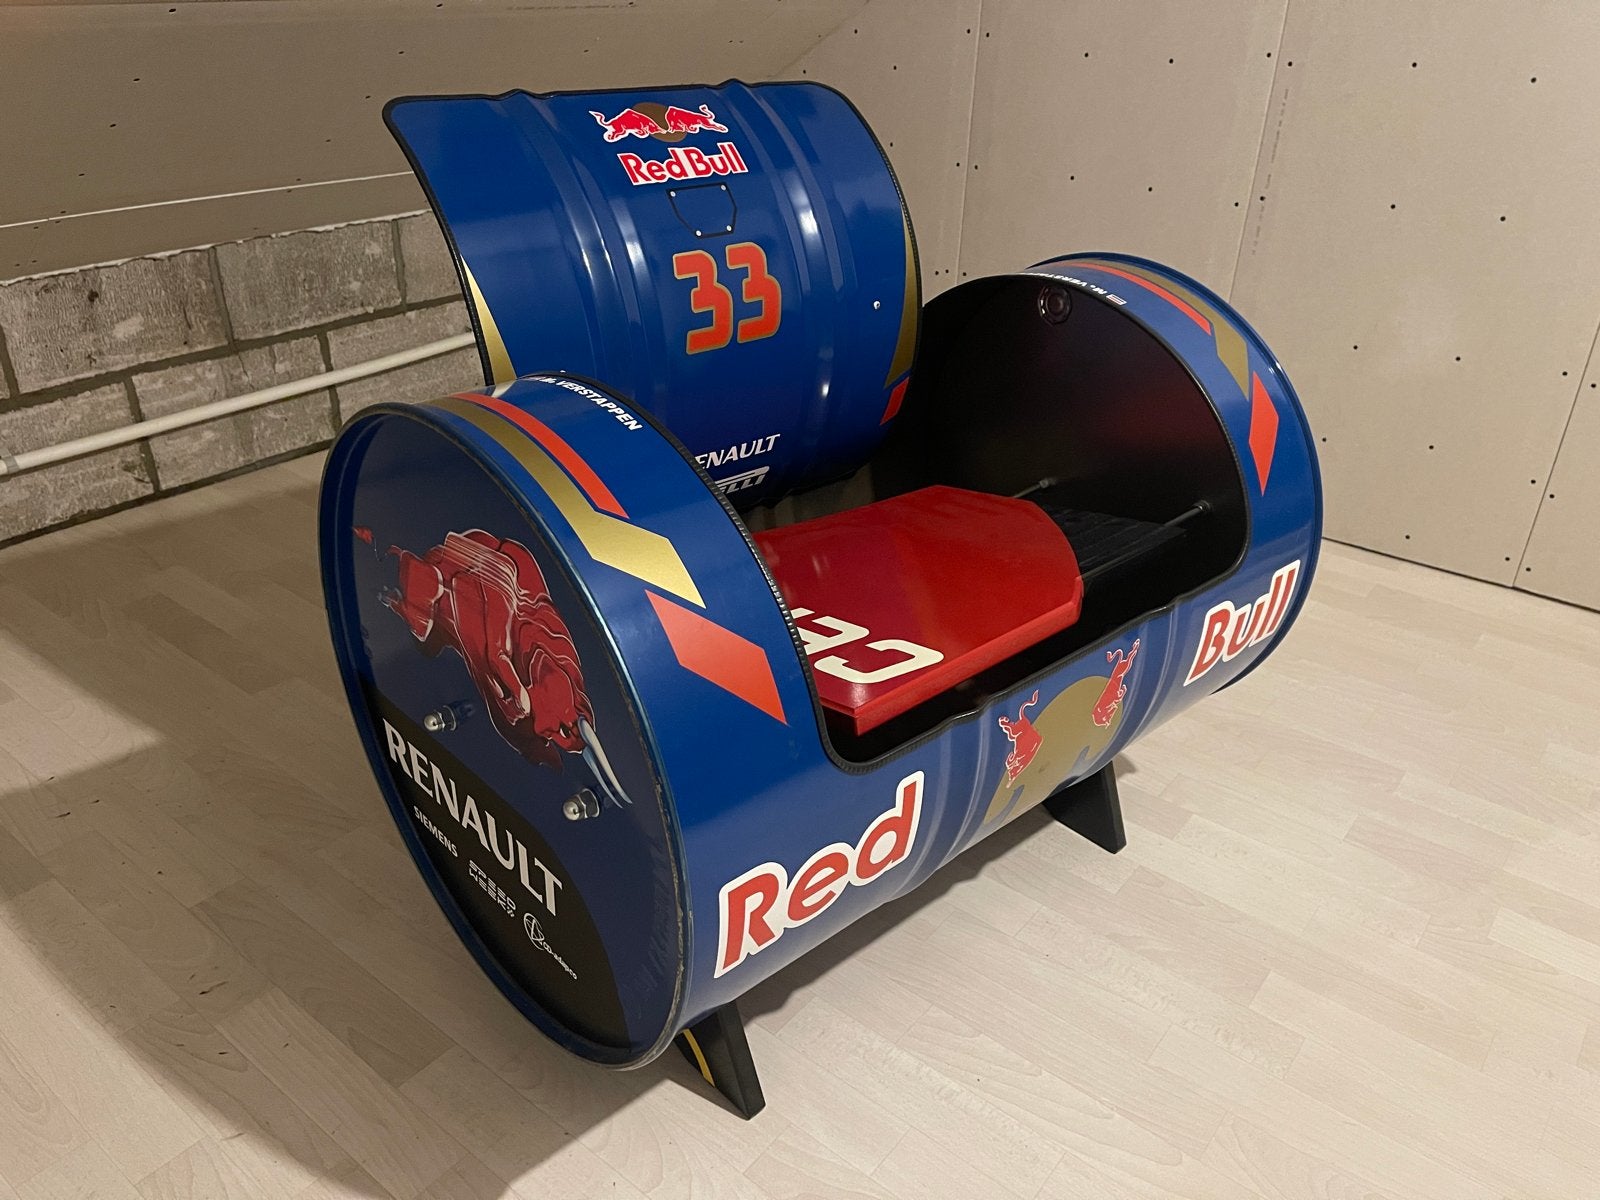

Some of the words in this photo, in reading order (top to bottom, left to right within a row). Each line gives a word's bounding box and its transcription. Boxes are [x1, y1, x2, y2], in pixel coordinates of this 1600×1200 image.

[618, 147, 689, 186] Red
[680, 141, 749, 178] Bull
[672, 241, 782, 355] 33
[556, 380, 643, 431] VERSTAPPEN
[695, 433, 781, 470] ENAULT
[713, 770, 925, 979] Red
[1184, 559, 1301, 687] Bull
[382, 717, 563, 917] RENAULT
[413, 804, 459, 858] SIEMENS
[469, 859, 517, 911] SPEED
